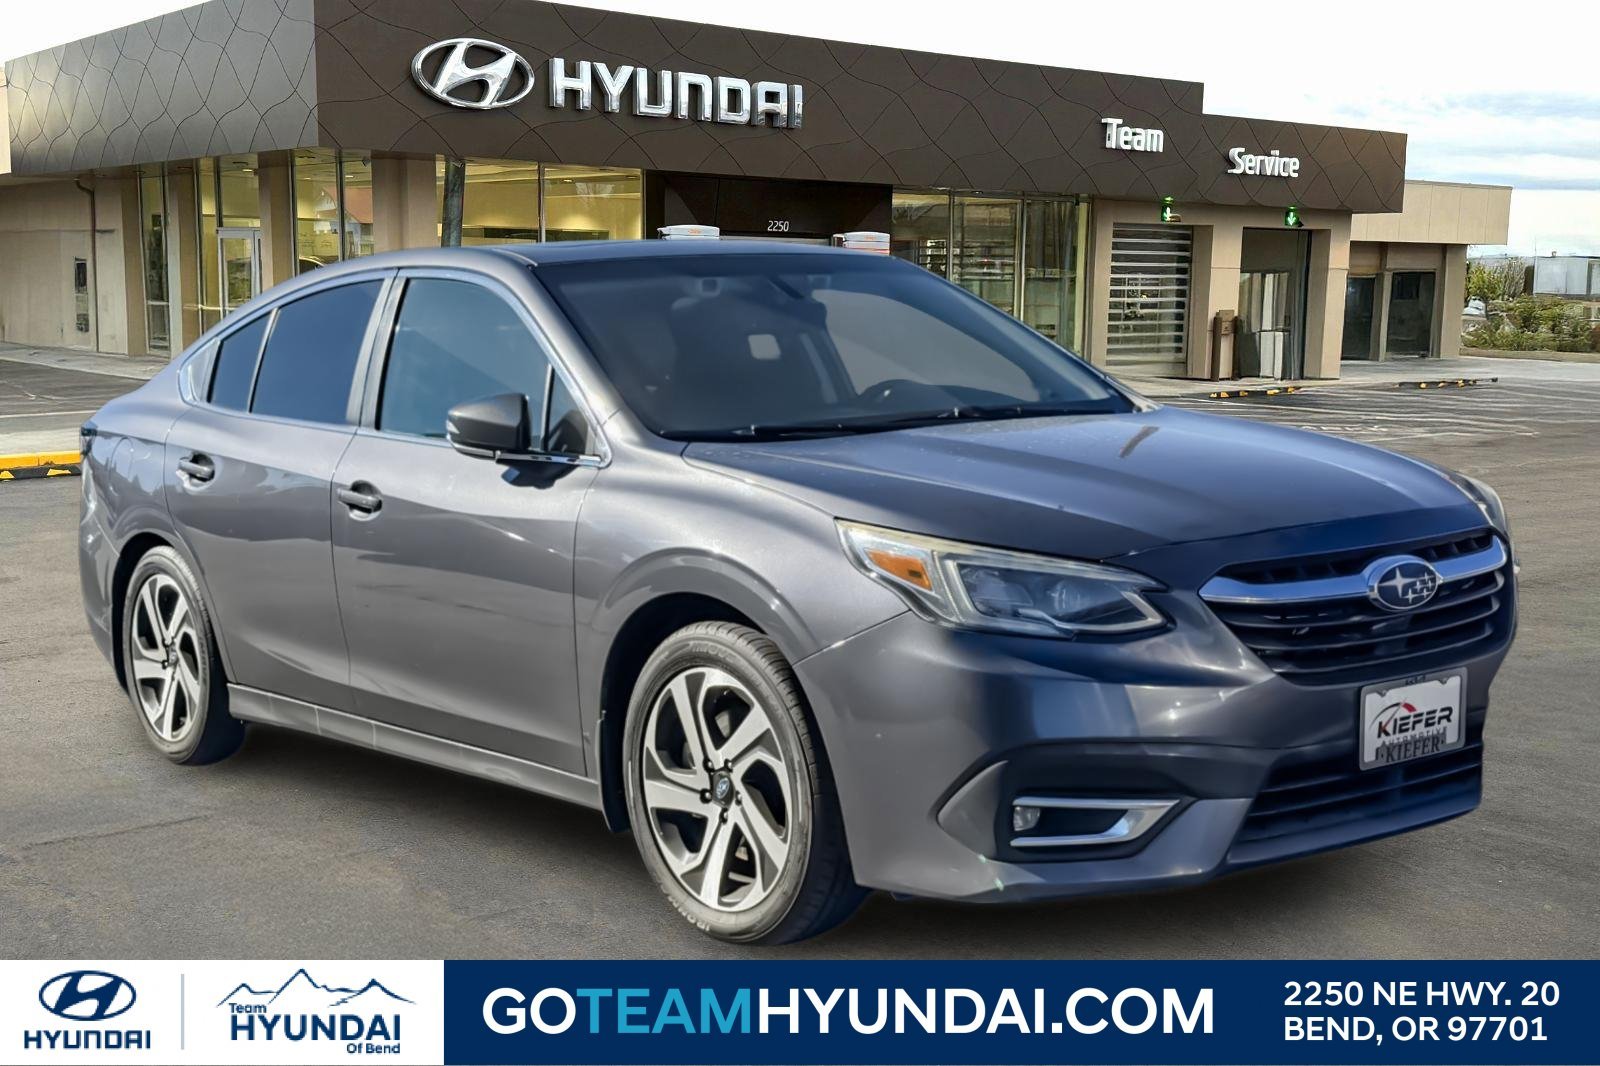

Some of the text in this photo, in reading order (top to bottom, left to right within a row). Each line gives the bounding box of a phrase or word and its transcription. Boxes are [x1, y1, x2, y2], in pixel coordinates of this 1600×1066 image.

[548, 57, 803, 129] HYUNDAI
[1101, 117, 1164, 153] Team
[1227, 147, 1299, 178] Service
[767, 220, 790, 232] 2250
[1377, 706, 1454, 738] KIEFER
